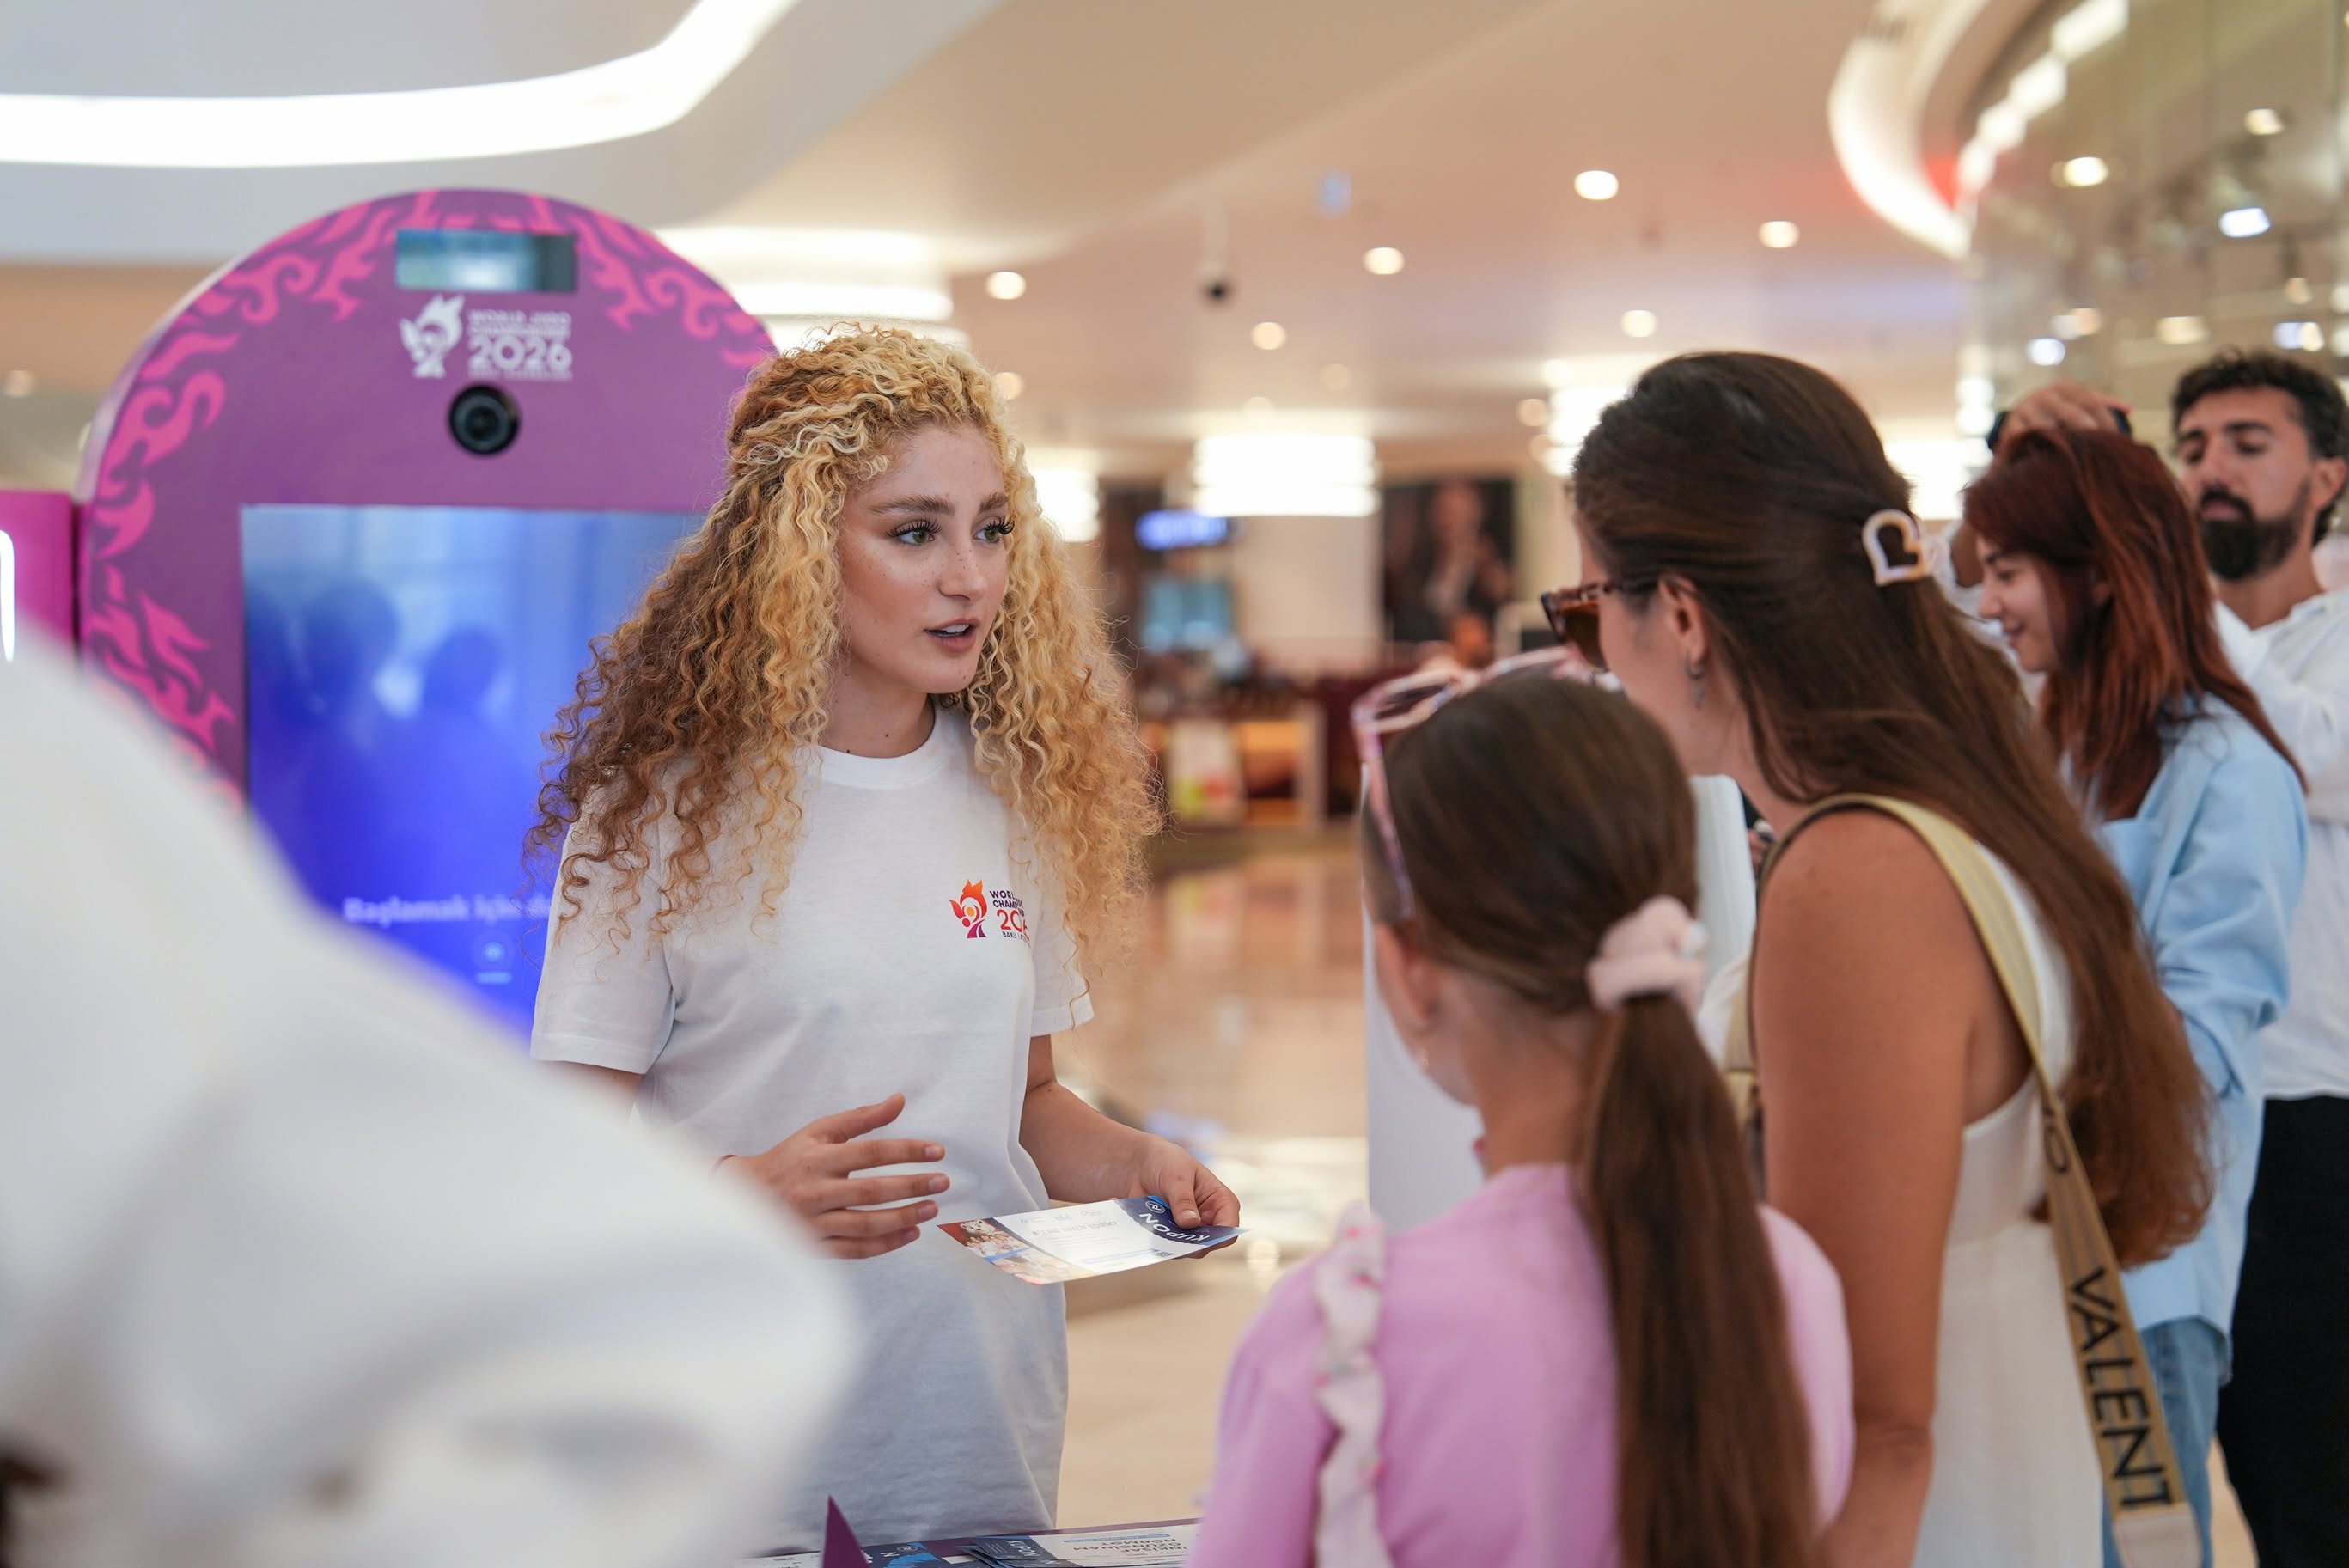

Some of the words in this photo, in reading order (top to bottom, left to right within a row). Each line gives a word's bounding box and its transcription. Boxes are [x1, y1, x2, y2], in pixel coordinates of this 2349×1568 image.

[468, 334, 573, 371] 2026
[990, 890, 1016, 900] WORL
[1138, 1211, 1211, 1242] KUPON
